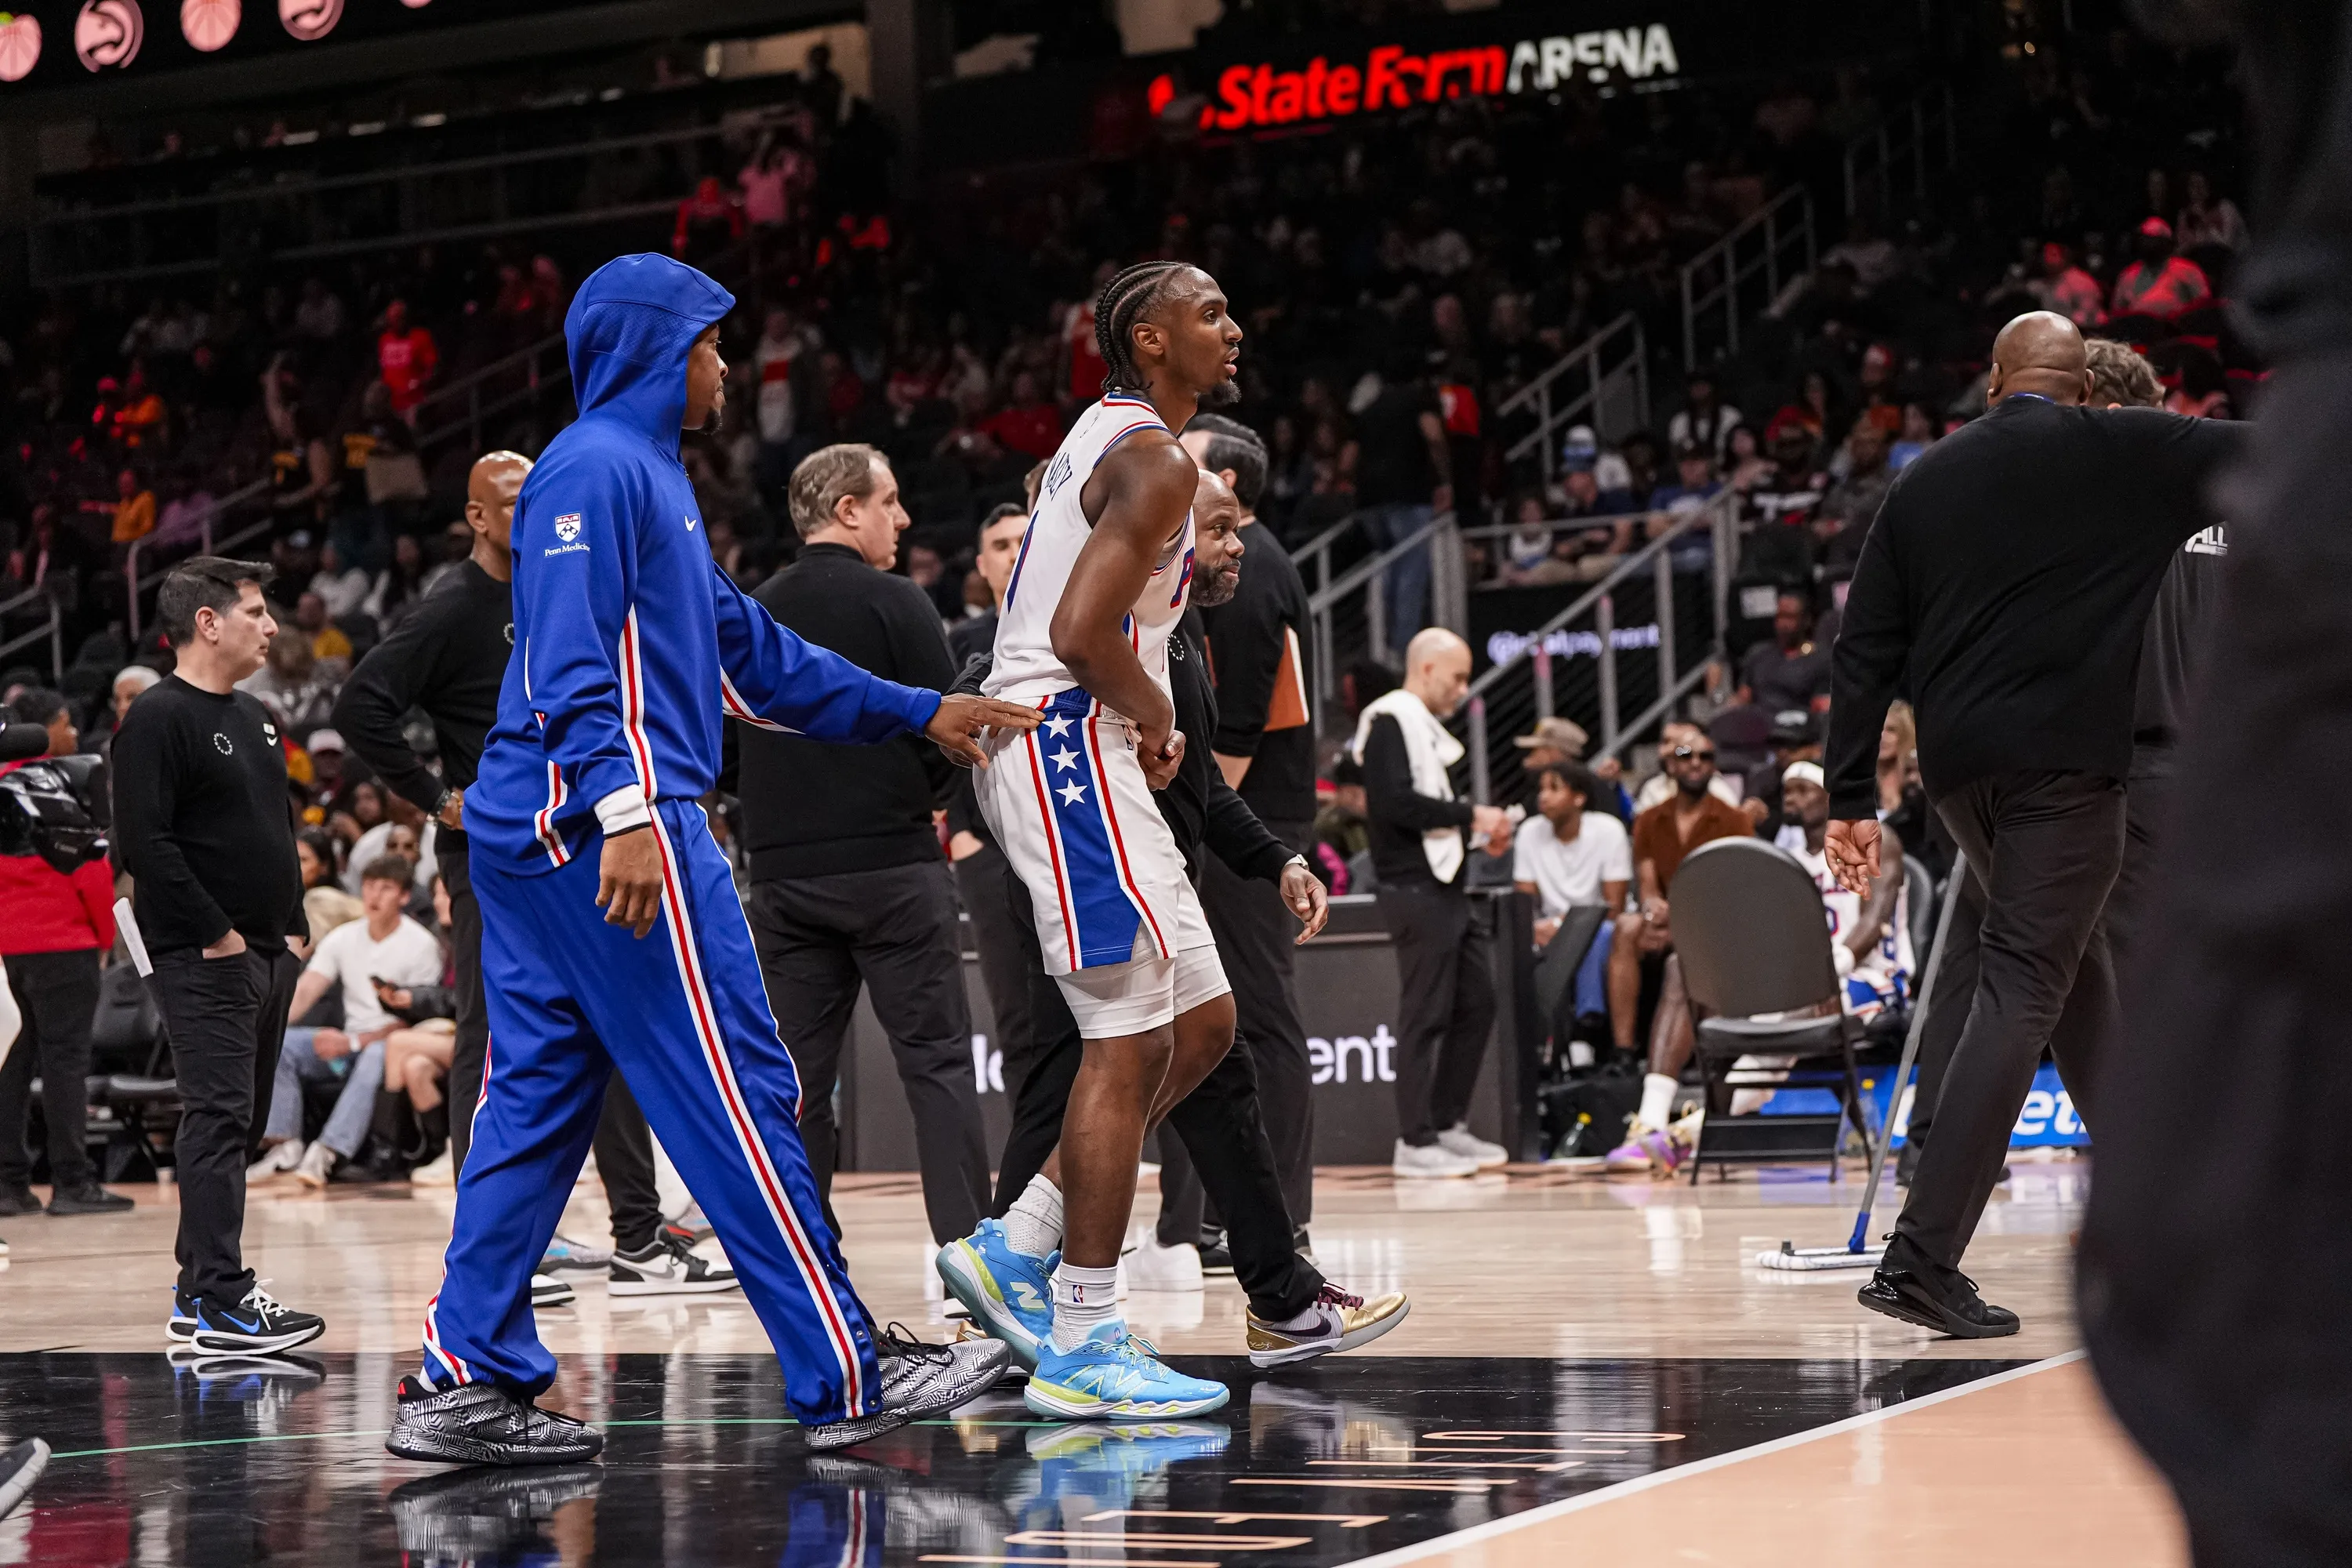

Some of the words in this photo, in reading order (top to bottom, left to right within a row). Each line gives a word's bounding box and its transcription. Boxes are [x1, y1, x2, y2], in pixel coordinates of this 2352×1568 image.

[1218, 56, 1360, 130] State
[1506, 23, 1679, 94] ARENA
[544, 548, 561, 557] Penn
[561, 543, 590, 553] Medicine
